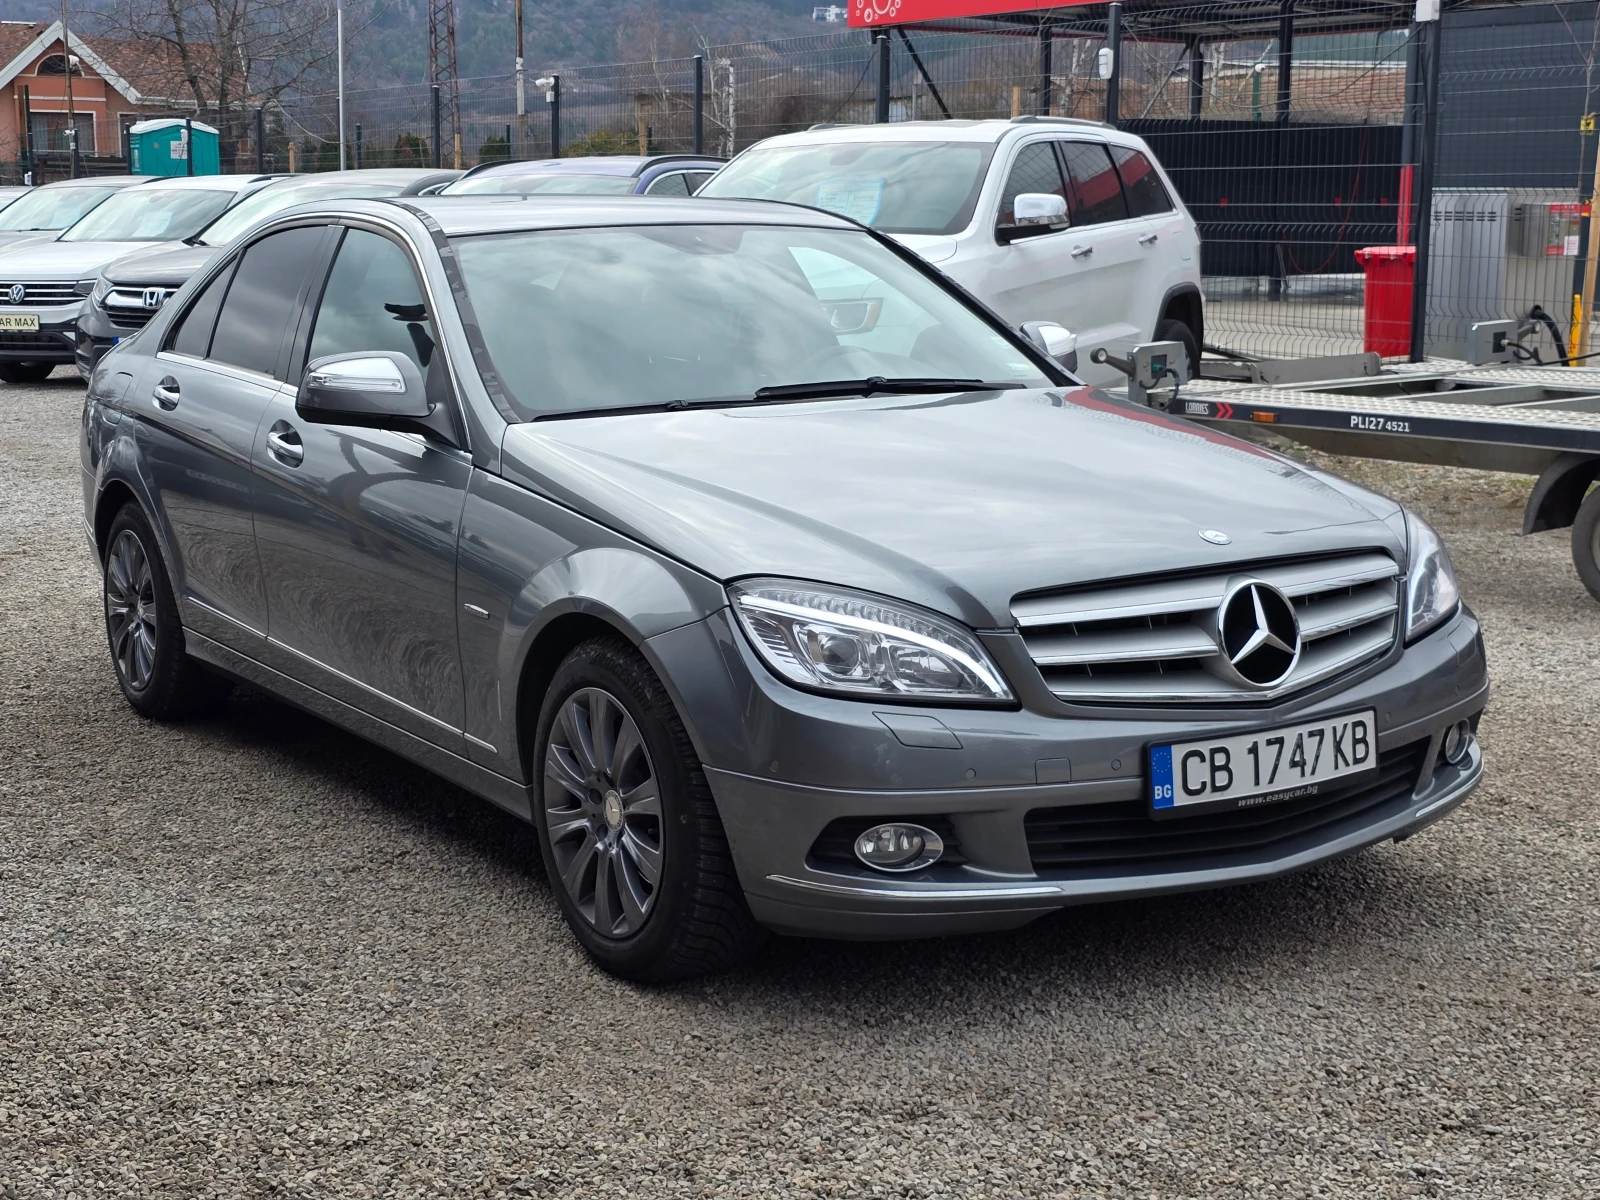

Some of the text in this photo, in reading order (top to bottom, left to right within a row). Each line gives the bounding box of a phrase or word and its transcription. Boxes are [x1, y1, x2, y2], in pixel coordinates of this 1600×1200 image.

[14, 317, 36, 327] MAX
[1385, 420, 1410, 433] 4521
[1181, 720, 1369, 796] CB 1747 KB
[1154, 784, 1172, 800] BG
[1237, 783, 1319, 807] www.easycar.bg
